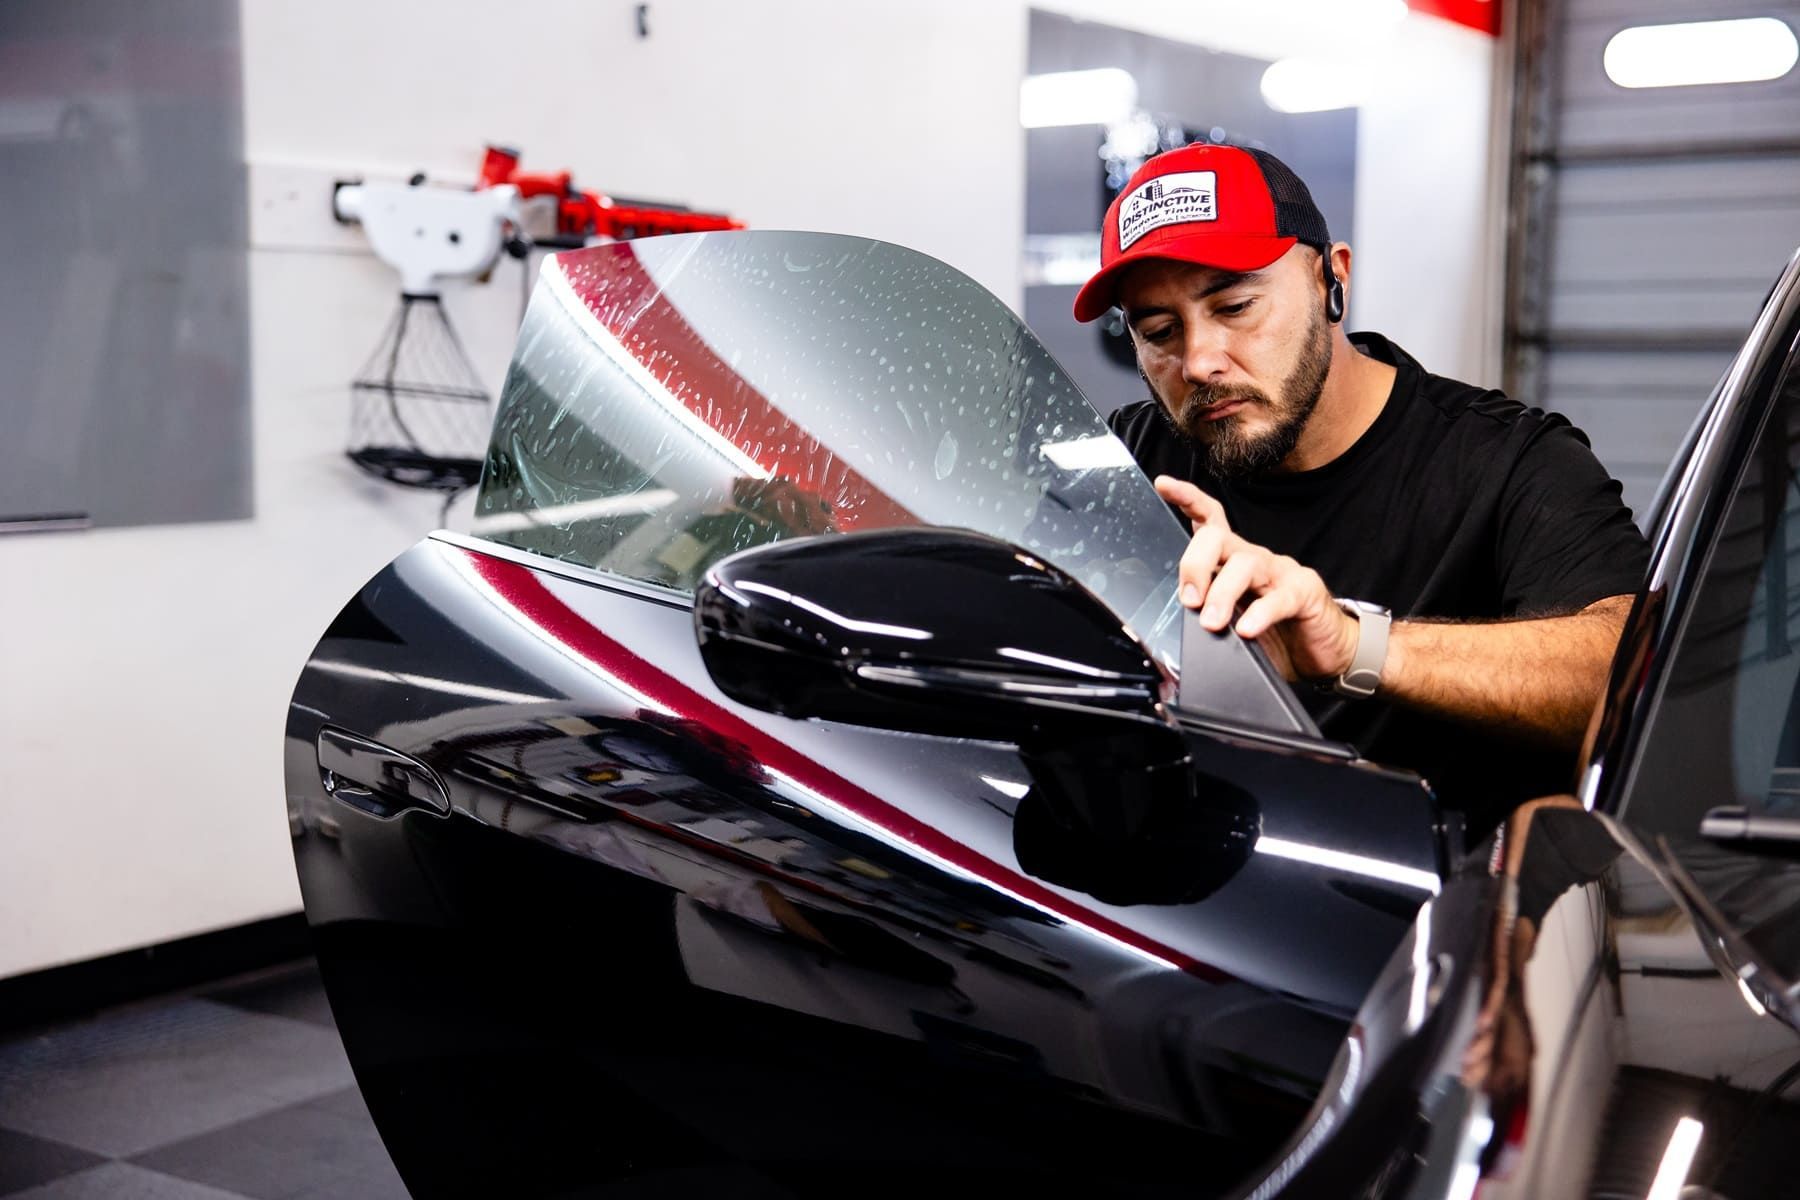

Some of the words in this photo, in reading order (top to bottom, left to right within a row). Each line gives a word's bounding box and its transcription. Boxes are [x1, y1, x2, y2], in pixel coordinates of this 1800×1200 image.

[1123, 195, 1211, 231] DISTINCTIVE
[1123, 214, 1159, 239] Window
[1165, 206, 1211, 215] Tinting
